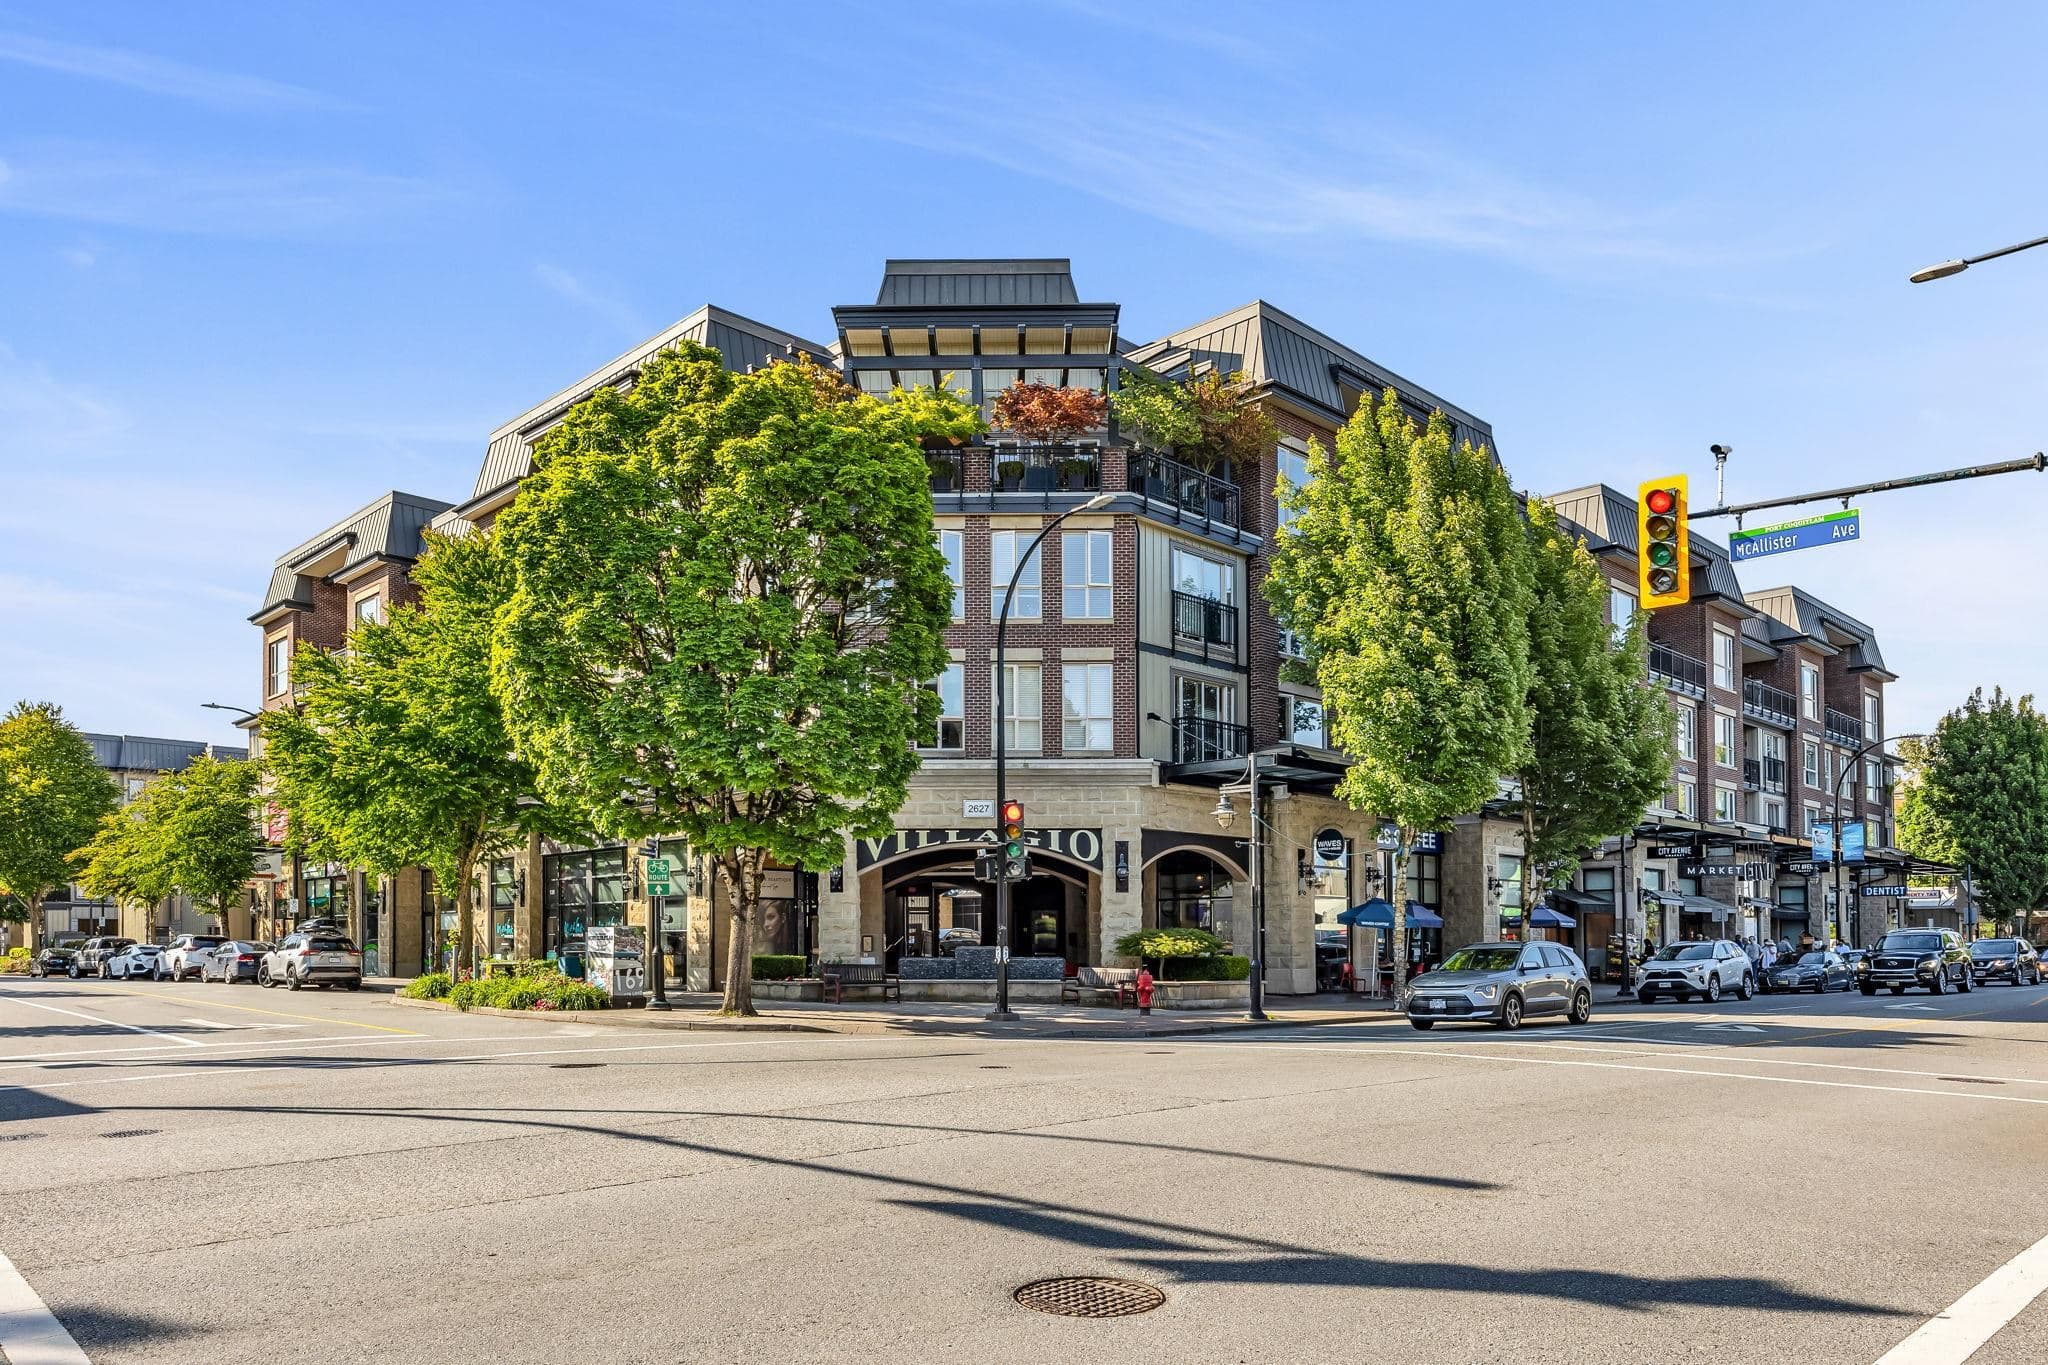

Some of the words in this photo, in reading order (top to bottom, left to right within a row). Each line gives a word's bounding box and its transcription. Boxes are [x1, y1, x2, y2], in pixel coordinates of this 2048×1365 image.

[1736, 534, 1798, 558] McAllister
[1832, 523, 1856, 539] Ave
[967, 804, 990, 813] 2627
[1317, 839, 1342, 848] WAVES
[1658, 847, 1670, 855] CITY
[1671, 846, 1692, 855] AVENUE
[1687, 866, 1742, 875] MARKET
[1789, 864, 1801, 872] CITY
[1866, 886, 1905, 896] DENTIST
